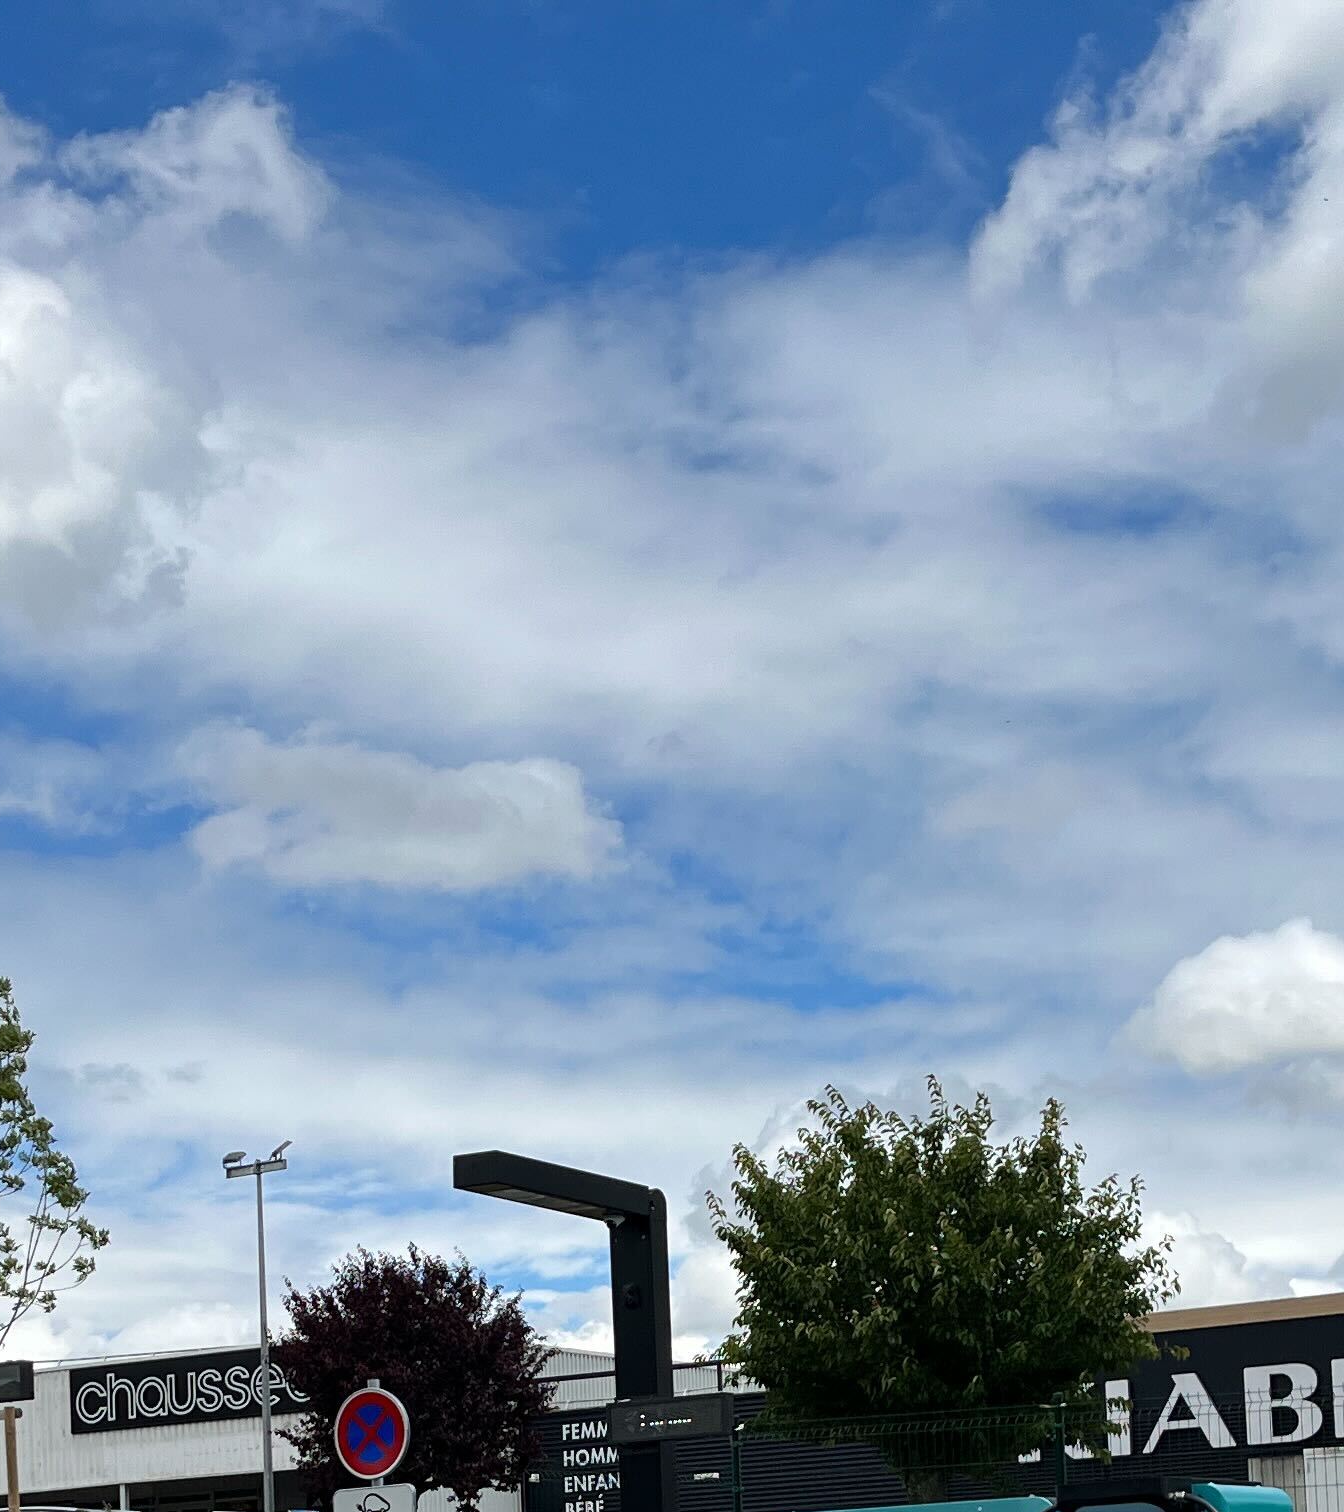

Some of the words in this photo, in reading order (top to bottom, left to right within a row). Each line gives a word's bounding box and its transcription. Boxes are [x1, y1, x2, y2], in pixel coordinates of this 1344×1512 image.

[562, 1420, 607, 1440] FEMM
[563, 1447, 619, 1466] HOMM
[564, 1472, 620, 1493] ENFAN
